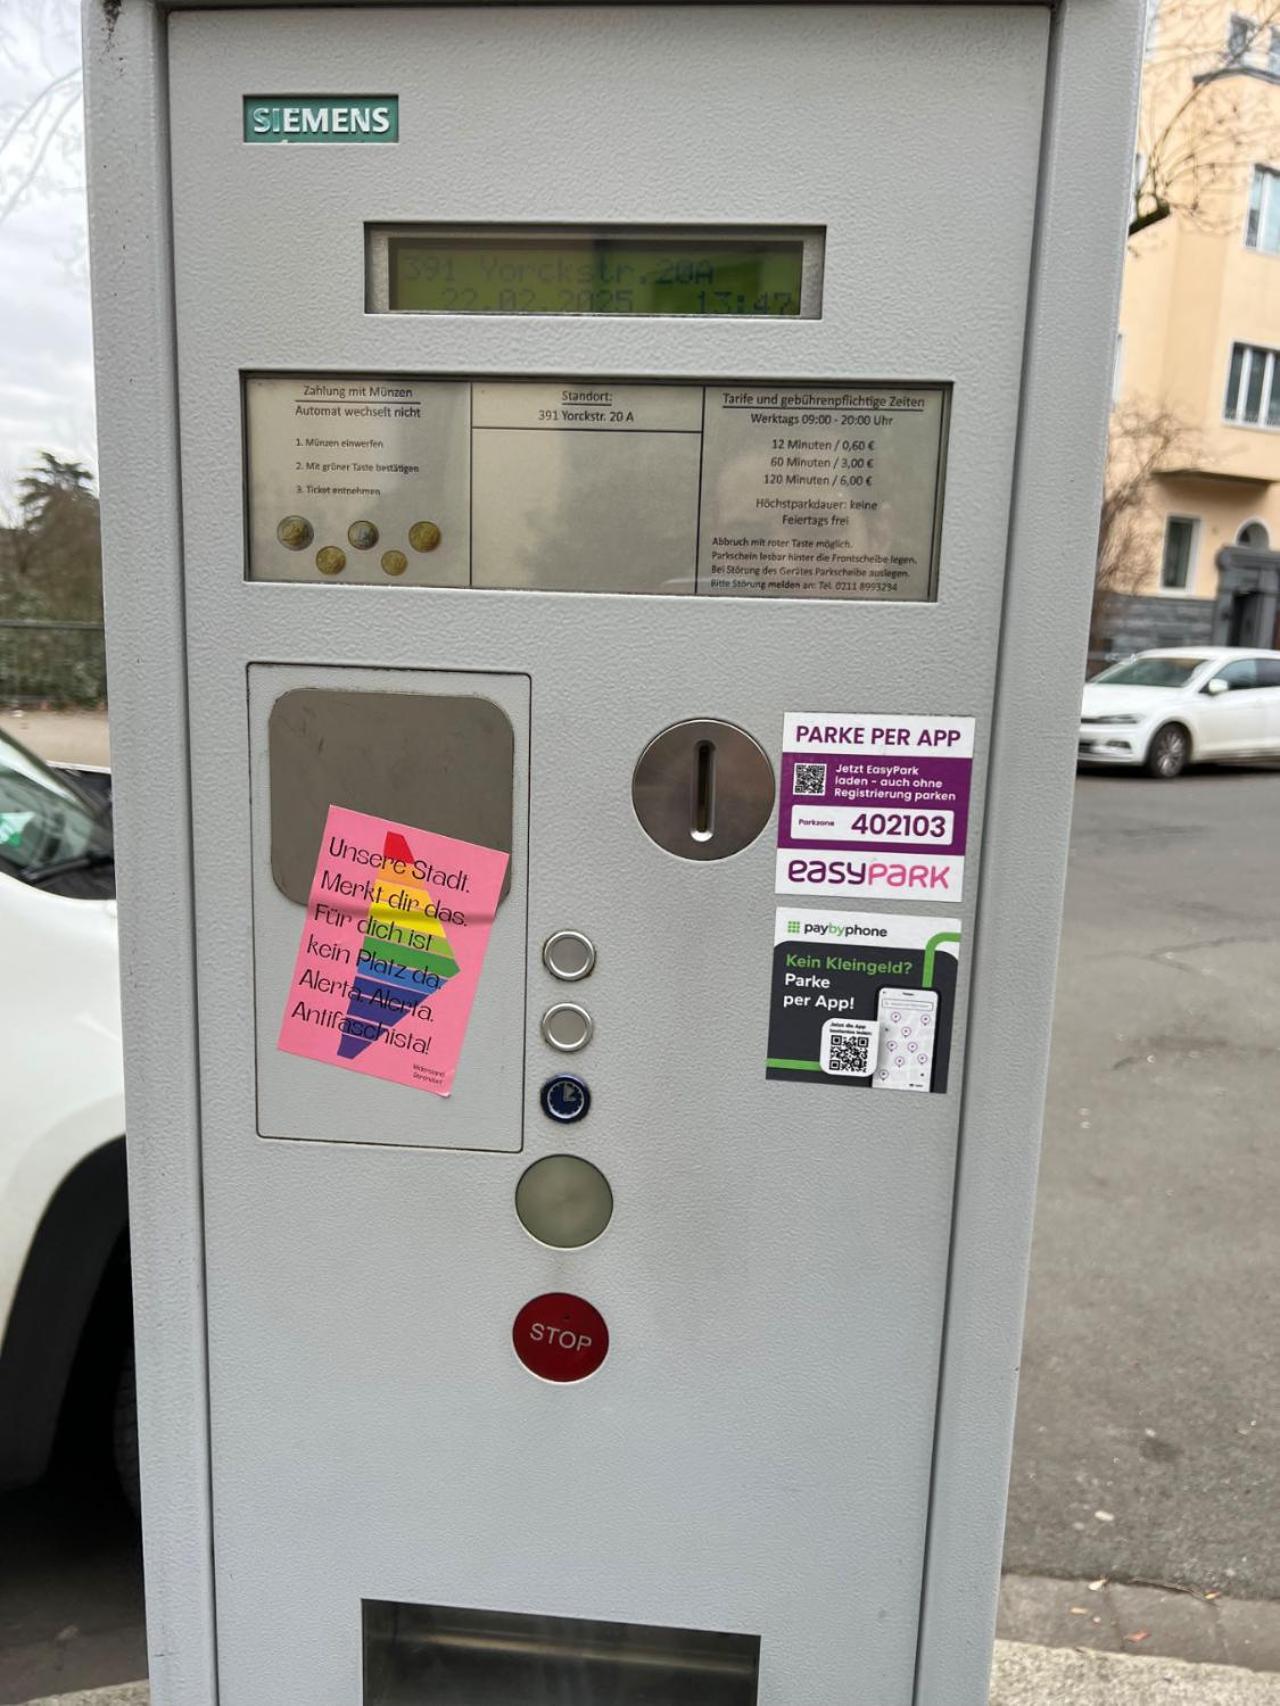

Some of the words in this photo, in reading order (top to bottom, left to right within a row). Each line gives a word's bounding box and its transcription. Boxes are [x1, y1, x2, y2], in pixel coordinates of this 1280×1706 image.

[253, 107, 390, 133] SIEMENS
[405, 256, 455, 283] 391
[304, 386, 345, 398] Zahlung
[350, 387, 366, 397] mit
[370, 387, 413, 398] Münzen
[562, 391, 613, 401] Standort:
[723, 393, 753, 405] Tarife
[757, 394, 778, 405] und
[781, 395, 886, 409] gebührenpflichtige
[890, 396, 925, 407] Zeiten
[296, 406, 341, 417] Automat
[344, 407, 391, 417] wechselt
[394, 407, 421, 418] nicht
[539, 410, 559, 421] 391
[562, 411, 606, 422] Yorckstr.
[610, 412, 624, 422] 20
[627, 412, 634, 422] A
[751, 414, 799, 426] Werktags
[802, 415, 831, 425] 09:00
[841, 415, 870, 425] 20:00
[874, 415, 893, 425] Uhr
[296, 438, 303, 447] 1.
[306, 438, 339, 447] Münzen
[341, 439, 383, 448] einwerfen
[772, 440, 785, 449] 12
[788, 440, 831, 450] Minuten
[834, 440, 840, 451] /
[842, 441, 865, 451] 0,60
[868, 441, 875, 450] €
[296, 463, 303, 471] 2.
[306, 463, 320, 471] Mit
[323, 463, 350, 473] grüner
[353, 463, 374, 472] Taste
[376, 464, 419, 475] bestätigen
[771, 458, 784, 468] 60
[786, 458, 830, 468] Minuten
[833, 458, 840, 469] /
[841, 459, 864, 469] 3,00
[867, 459, 874, 468] €
[764, 475, 783, 485] 120
[786, 475, 829, 486] Minuten
[832, 475, 838, 486] /
[840, 476, 863, 487] 6,00
[866, 477, 872, 486] €
[307, 485, 331, 494] Ticket
[333, 486, 381, 496] entnehmen
[756, 498, 847, 510] Höchstparkdauer:
[850, 500, 878, 511] keine
[782, 515, 829, 527] Feiertags
[832, 515, 849, 526] frei
[712, 537, 749, 547] Abbruch
[751, 538, 765, 547] mit
[767, 539, 789, 548] roter
[792, 539, 813, 548] Taste
[816, 539, 853, 549] möglich.
[712, 552, 757, 561] Parkschein
[760, 553, 785, 561] lesbar
[788, 553, 814, 562] hinter
[816, 554, 829, 562] die
[832, 554, 888, 564] Frontscheibe
[890, 555, 917, 565] legen.
[712, 565, 725, 574] Bei
[727, 565, 760, 576] Störung
[762, 566, 777, 575] des
[780, 567, 812, 576] Gerätes
[816, 567, 867, 577] Parkscheibe
[870, 569, 910, 579] auslegen.
[711, 580, 730, 589] Bitte
[732, 580, 765, 590] Störung
[768, 581, 800, 590] melden
[835, 582, 857, 591] 0211
[796, 726, 865, 744] PARKE
[871, 728, 910, 745] PER
[917, 730, 961, 747] APP
[835, 764, 863, 774] Jetzt
[867, 765, 919, 776] EasyPark
[835, 776, 868, 786] laden
[880, 778, 910, 787] auch
[913, 779, 943, 788] ohne
[835, 788, 912, 801] Registrierung
[915, 792, 956, 803] parken
[799, 819, 835, 827] Parkzone
[851, 814, 946, 838] 402103
[329, 836, 407, 875] Unsere
[412, 860, 470, 894] Stadt.
[320, 870, 383, 904] Merkt
[388, 889, 420, 912] dir
[424, 900, 468, 927] das.
[314, 903, 352, 928] Für
[357, 917, 402, 944] dich
[408, 930, 432, 951] ist
[804, 923, 888, 937] paybyphone
[307, 934, 350, 964] kein
[356, 950, 408, 980] Platz
[412, 964, 442, 990] da.
[786, 954, 821, 968] Kein
[827, 957, 913, 976] Kleingeld?
[785, 973, 830, 989] Parke
[368, 988, 434, 1022] Alerta.
[784, 995, 811, 1008] per
[815, 995, 855, 1011] App!
[292, 1001, 432, 1055] Antifaschista!
[529, 1323, 592, 1351] STOP
